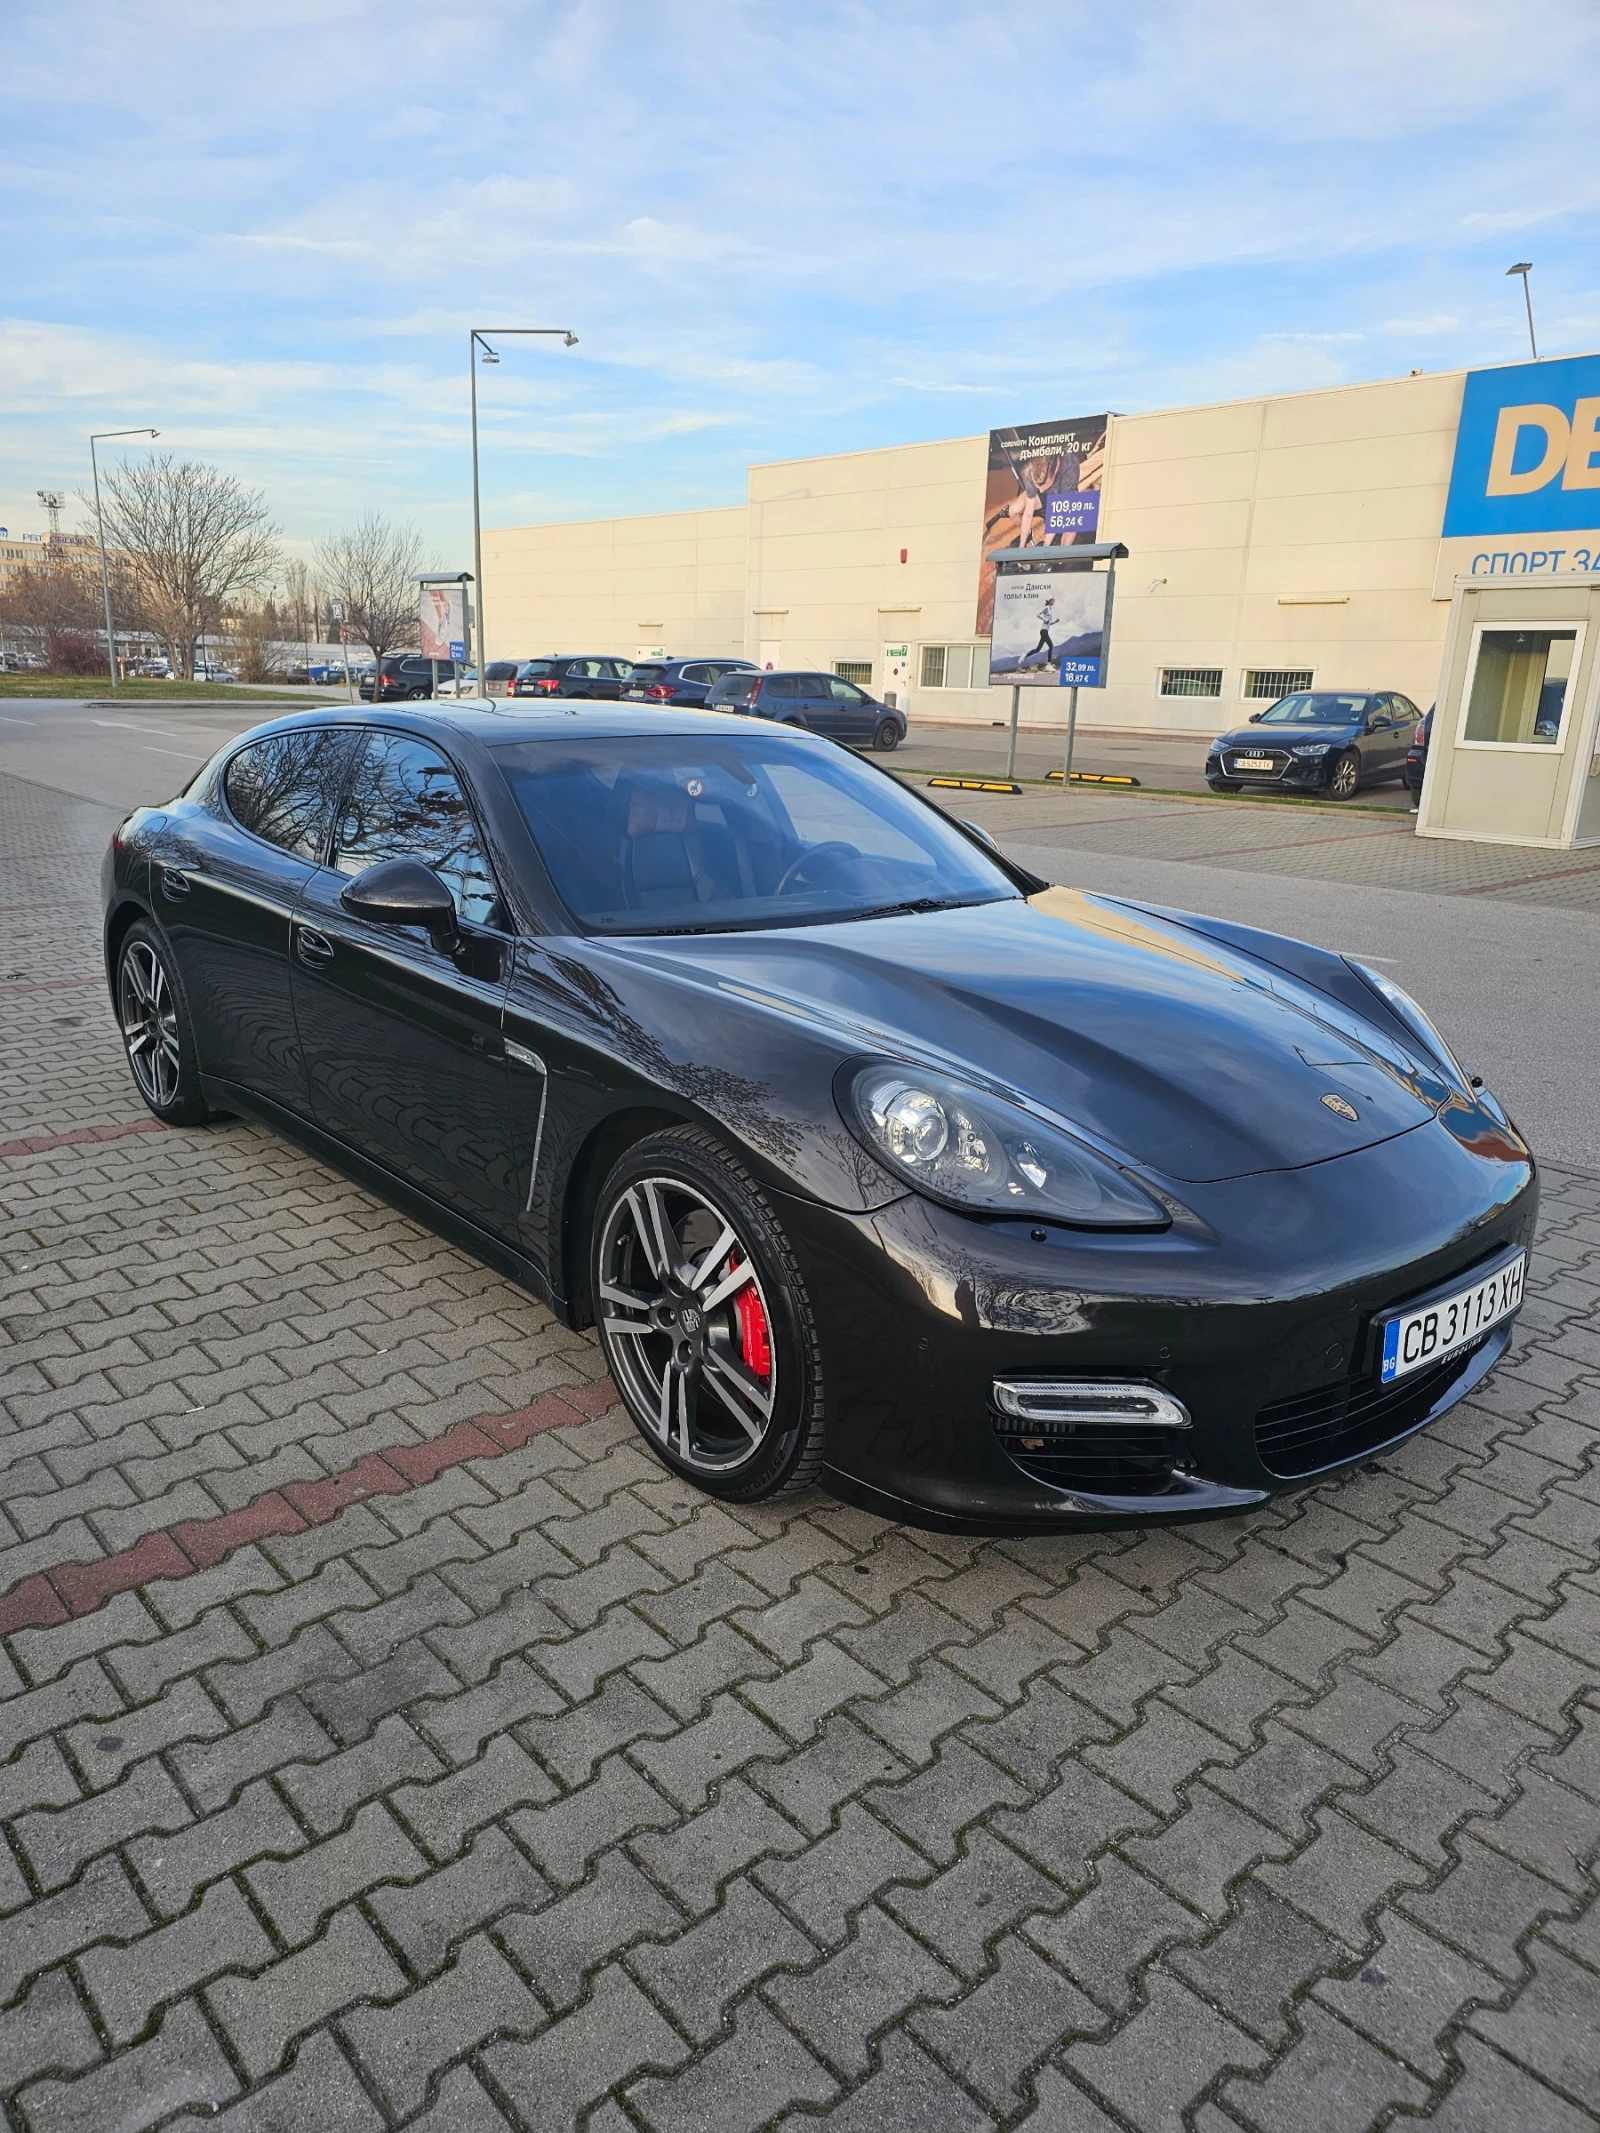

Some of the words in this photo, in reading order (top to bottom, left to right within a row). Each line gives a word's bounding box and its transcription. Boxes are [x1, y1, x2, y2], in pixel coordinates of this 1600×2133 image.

[1028, 433, 1076, 447] Комплект
[1020, 446, 1064, 461] дъмбели,
[1066, 442, 1080, 454] 20
[1081, 441, 1093, 452] кг
[1051, 500, 1082, 514] 109,99
[1083, 502, 1095, 511] лв.
[1049, 516, 1076, 529] 56,24
[1077, 516, 1084, 526] €
[1471, 550, 1566, 575] СПОРТ
[1025, 583, 1052, 592] Дамски
[1065, 662, 1087, 672] 32,99
[1065, 673, 1084, 684] 16,87
[1403, 1312, 1439, 1364] CB
[1442, 1281, 1497, 1346] 3113
[1498, 1260, 1523, 1314] XH
[745, 1305, 754, 1367] PORSCHE
[1383, 1356, 1396, 1372] BG
